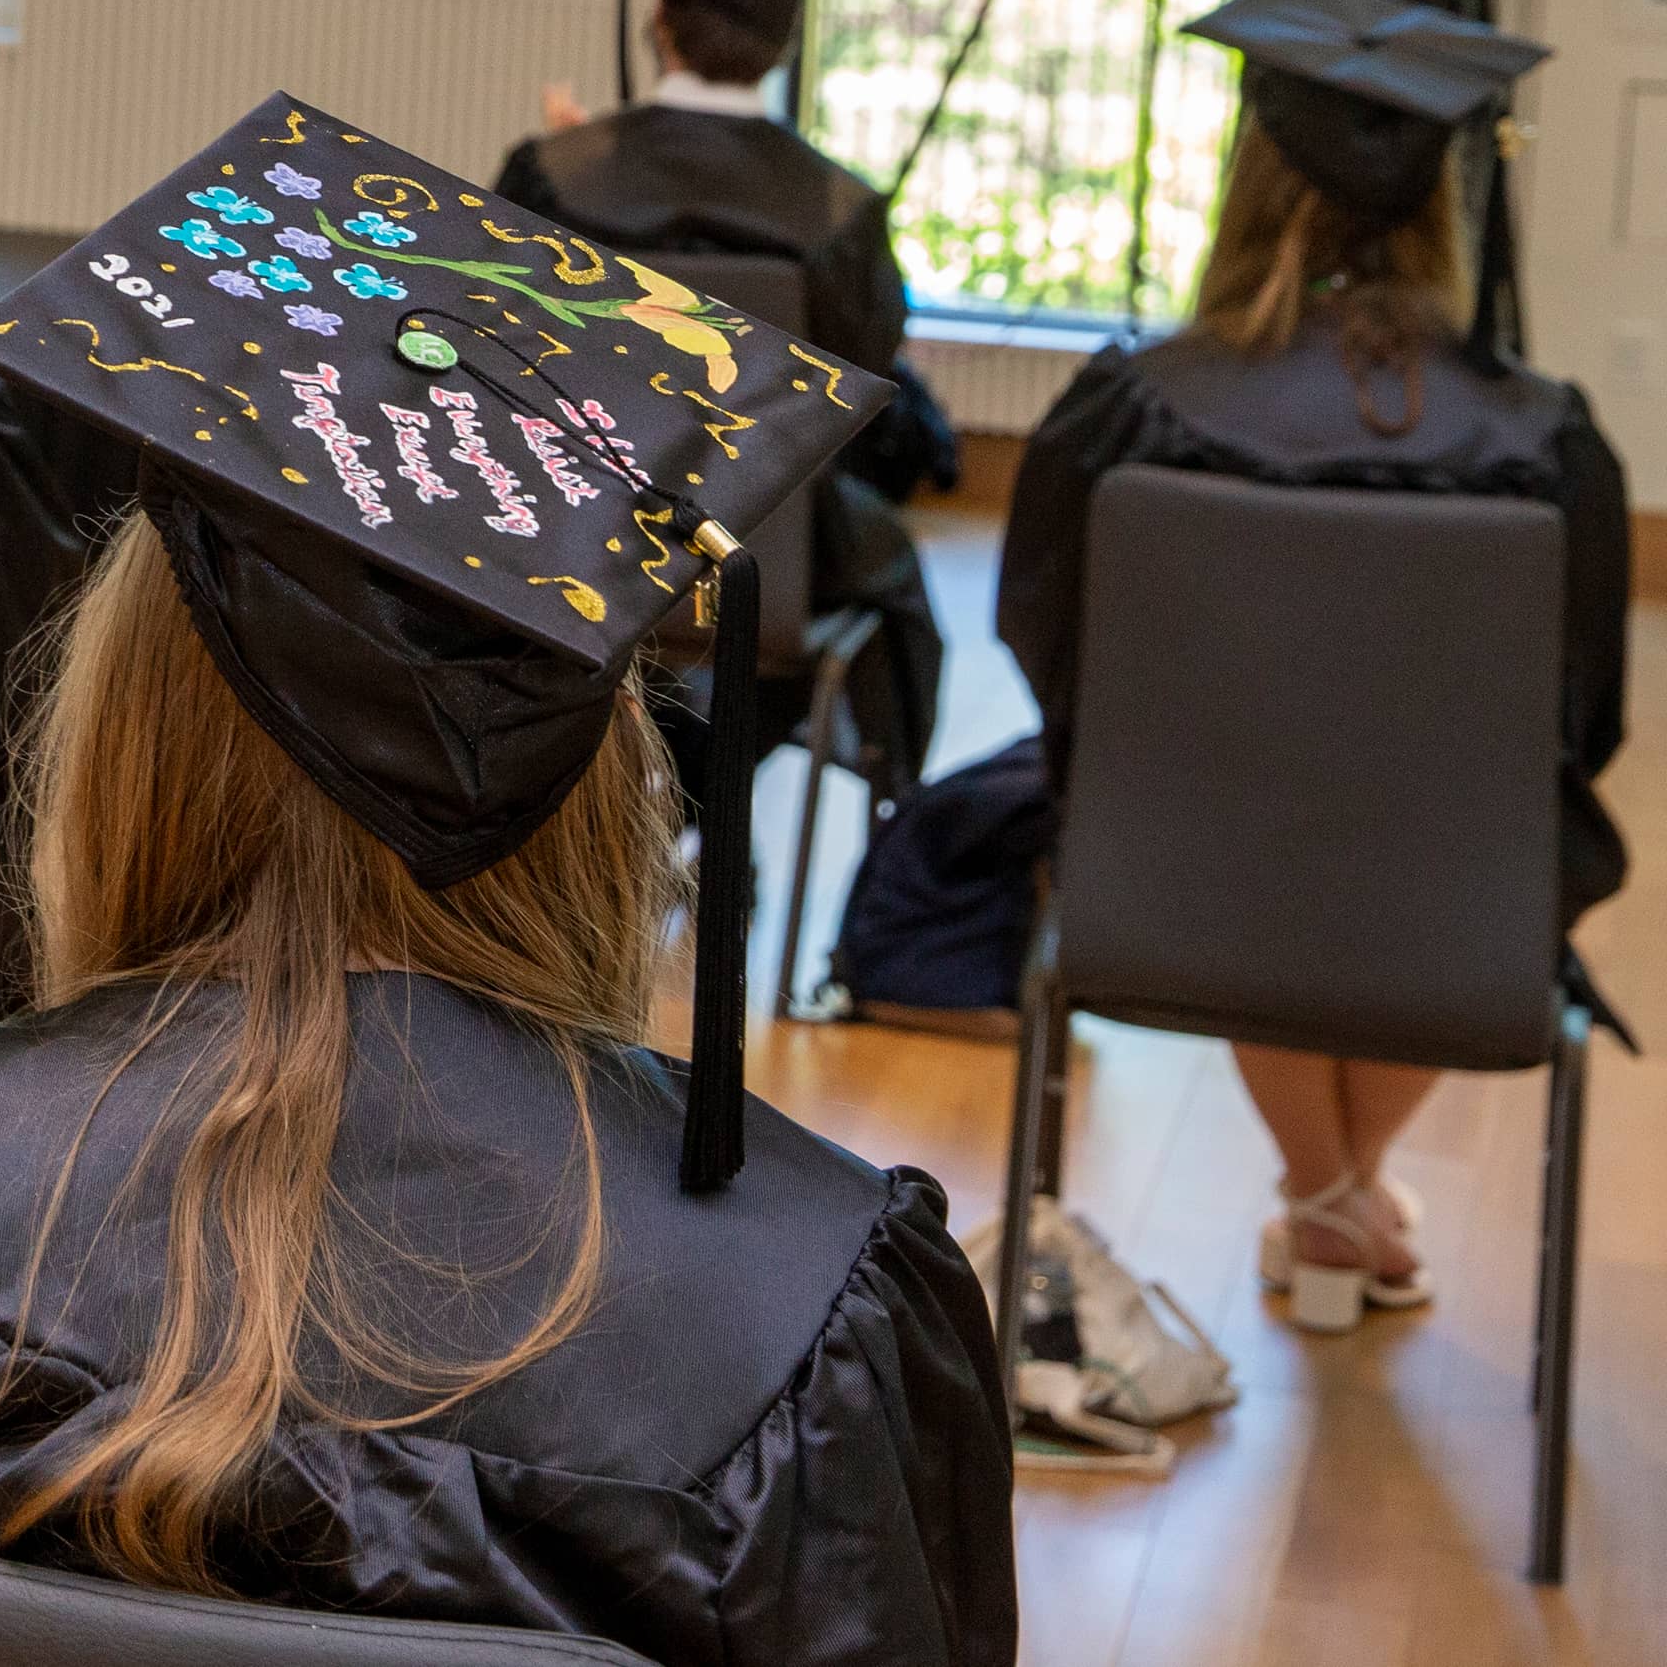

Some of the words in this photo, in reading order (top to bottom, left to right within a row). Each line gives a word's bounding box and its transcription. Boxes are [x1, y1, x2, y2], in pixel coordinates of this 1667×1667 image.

[88, 253, 195, 328] 2021
[279, 361, 394, 530] Temptation
[378, 402, 460, 504] Except
[428, 385, 541, 538] Everything
[510, 412, 602, 508] Resist
